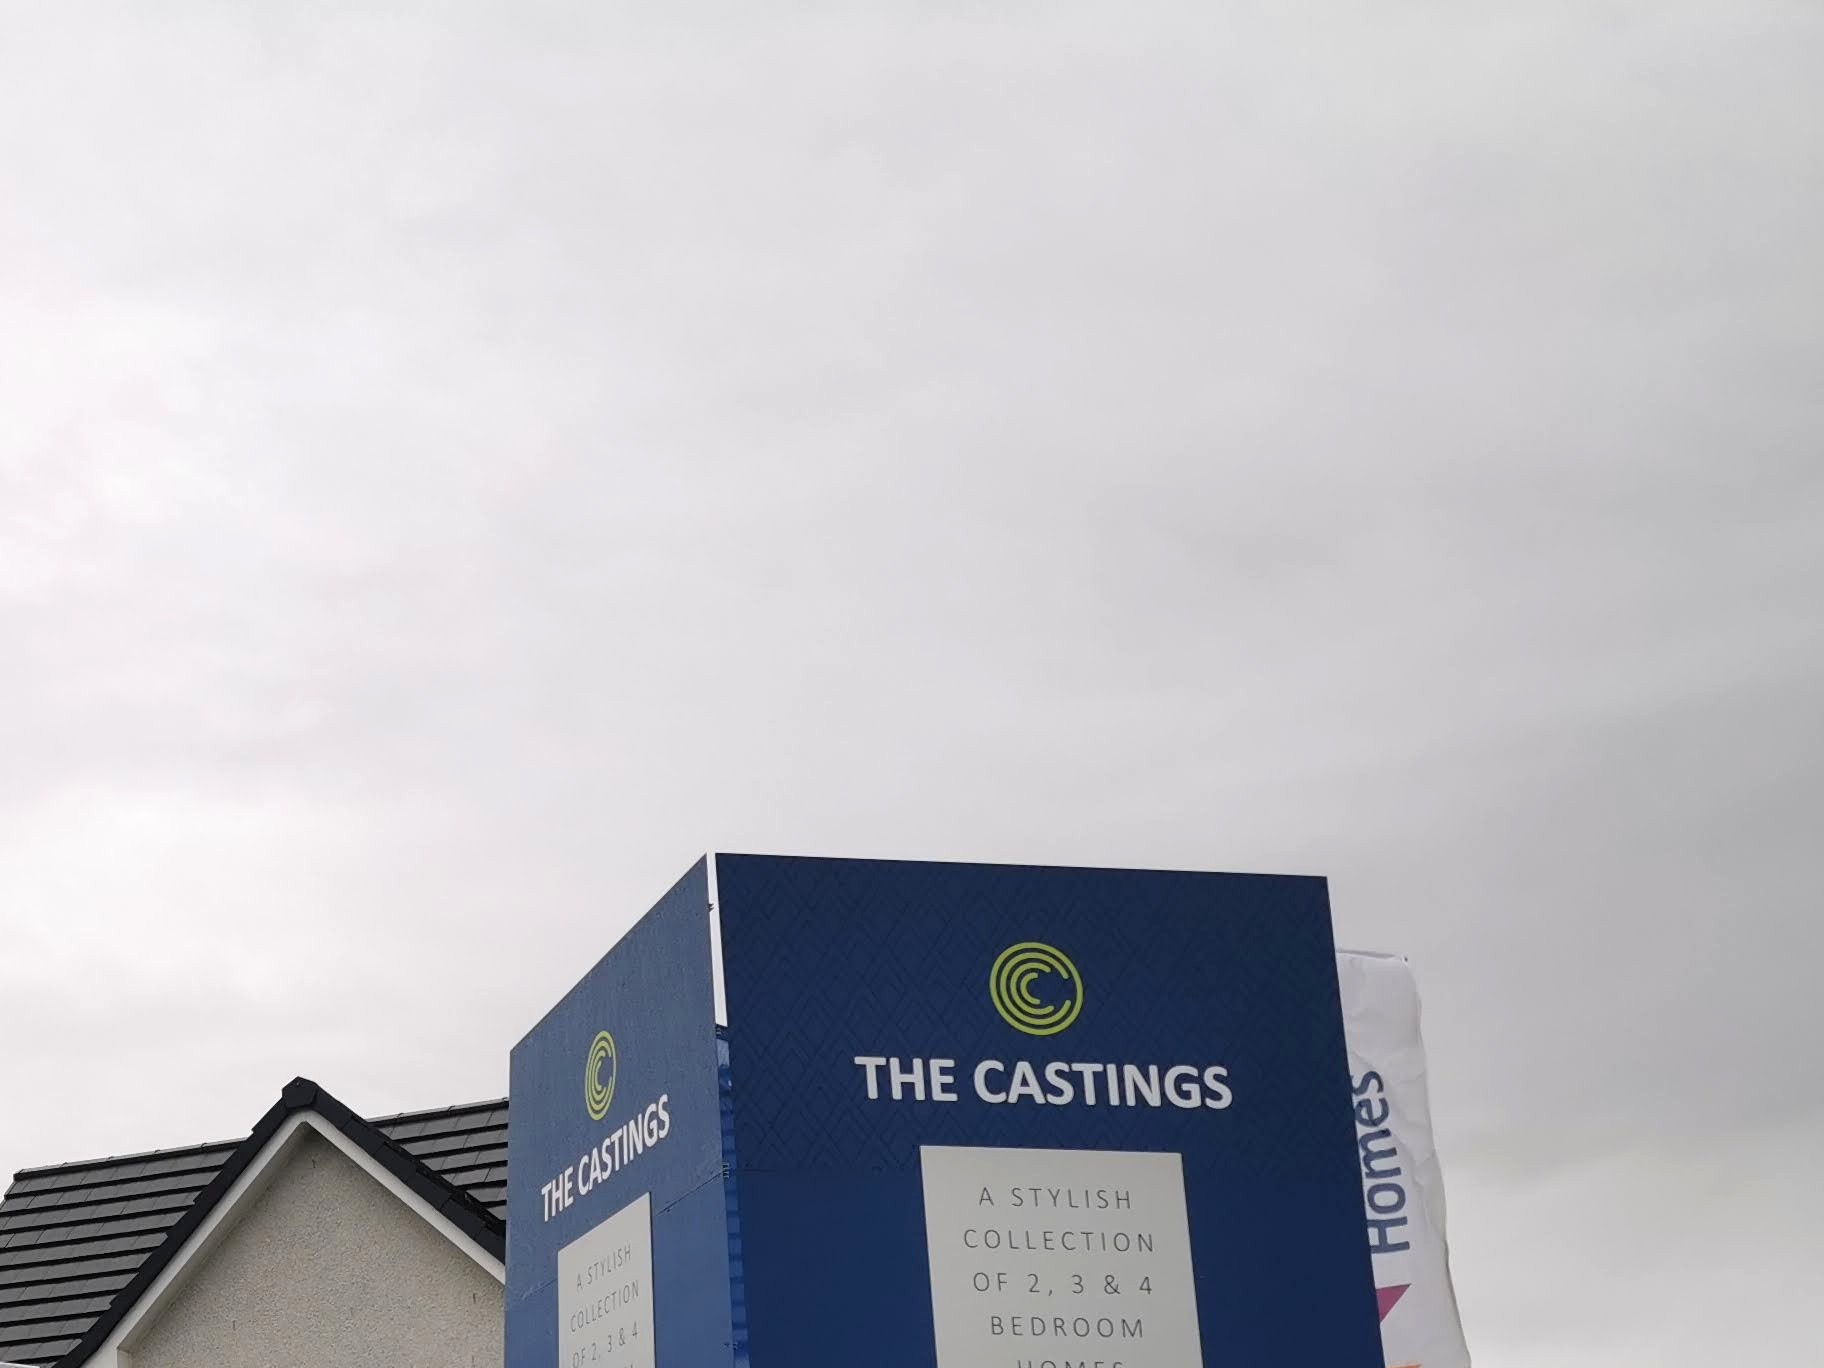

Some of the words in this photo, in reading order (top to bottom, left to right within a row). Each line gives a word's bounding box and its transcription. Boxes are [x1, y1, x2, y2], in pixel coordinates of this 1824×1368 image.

[855, 1056, 957, 1102] THE
[974, 1060, 1233, 1110] CASTINGS
[541, 1167, 574, 1222] THE
[578, 1094, 670, 1195] CASTINGS
[1351, 1069, 1411, 1255] Homes
[979, 1187, 994, 1206] A
[1012, 1188, 1133, 1210] STYLISH
[963, 1228, 1155, 1253] COLLECTION
[587, 1246, 631, 1284] STYLISH
[973, 1273, 1009, 1293] OF
[1028, 1273, 1054, 1296] 2,
[1072, 1274, 1085, 1294] 3
[1139, 1276, 1153, 1295] 4
[571, 1280, 639, 1332] COLLECTION
[991, 1316, 1144, 1339] BEDROOM
